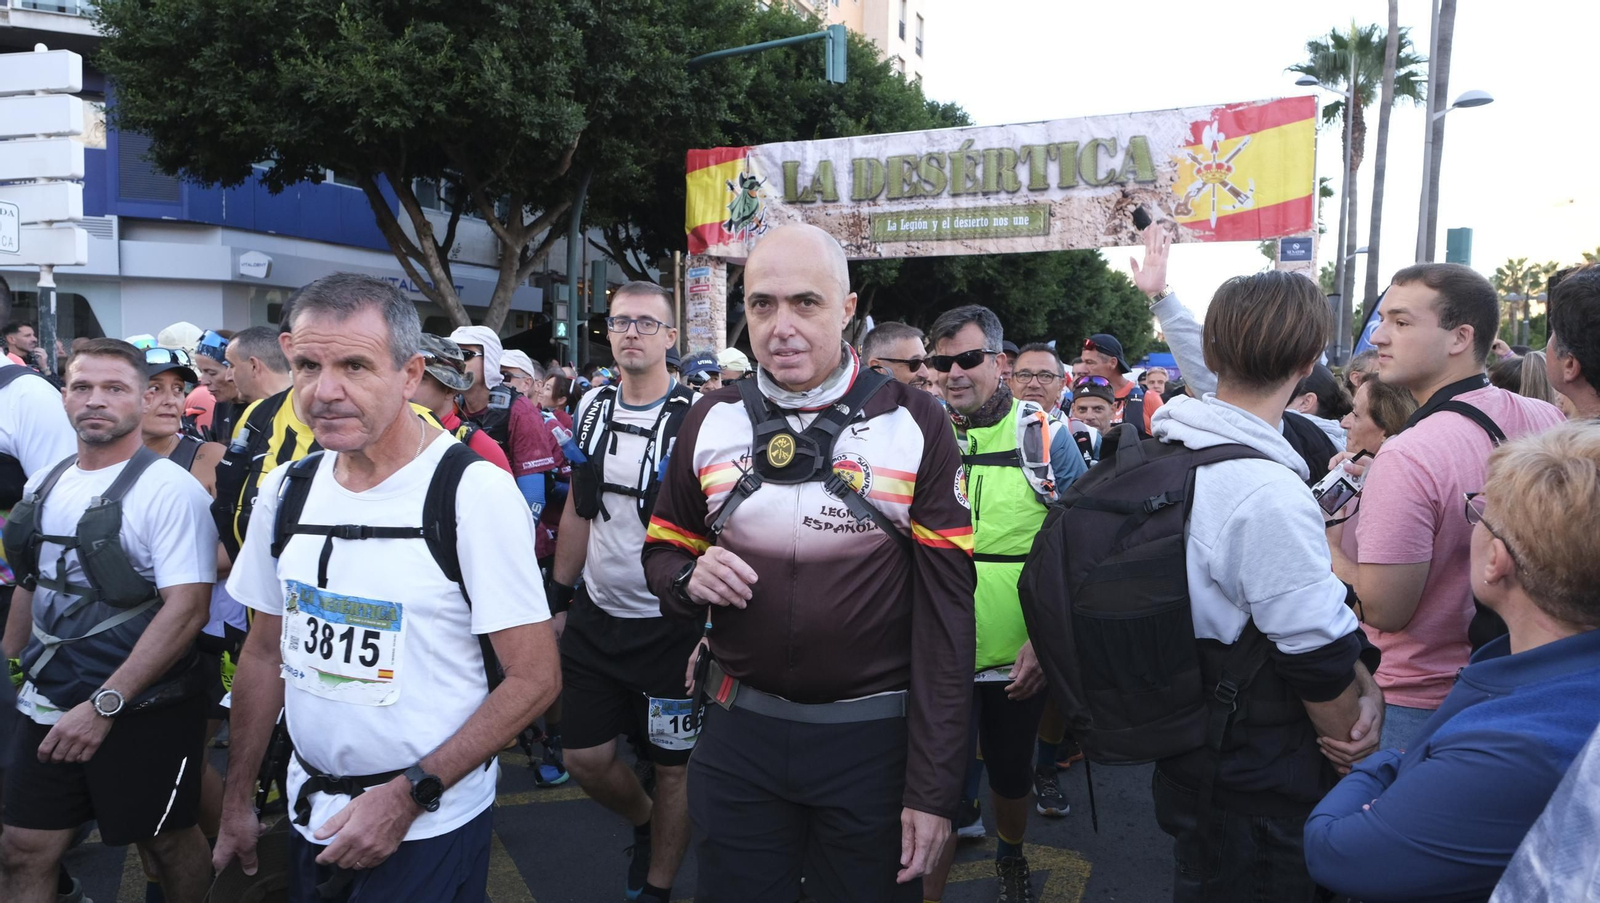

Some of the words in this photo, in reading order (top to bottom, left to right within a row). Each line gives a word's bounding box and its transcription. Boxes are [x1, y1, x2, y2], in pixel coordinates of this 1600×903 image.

[781, 158, 838, 206] LA
[851, 133, 1158, 202] DESÉRTICA
[887, 219, 897, 231] La
[900, 217, 928, 232] Legión
[932, 220, 938, 231] y
[942, 216, 950, 229] el
[953, 215, 989, 228] desierto
[993, 216, 1009, 227] nos
[1013, 215, 1030, 226] une
[579, 400, 603, 449] DORNNA
[820, 505, 868, 519] LEGI
[304, 616, 381, 668] 3815
